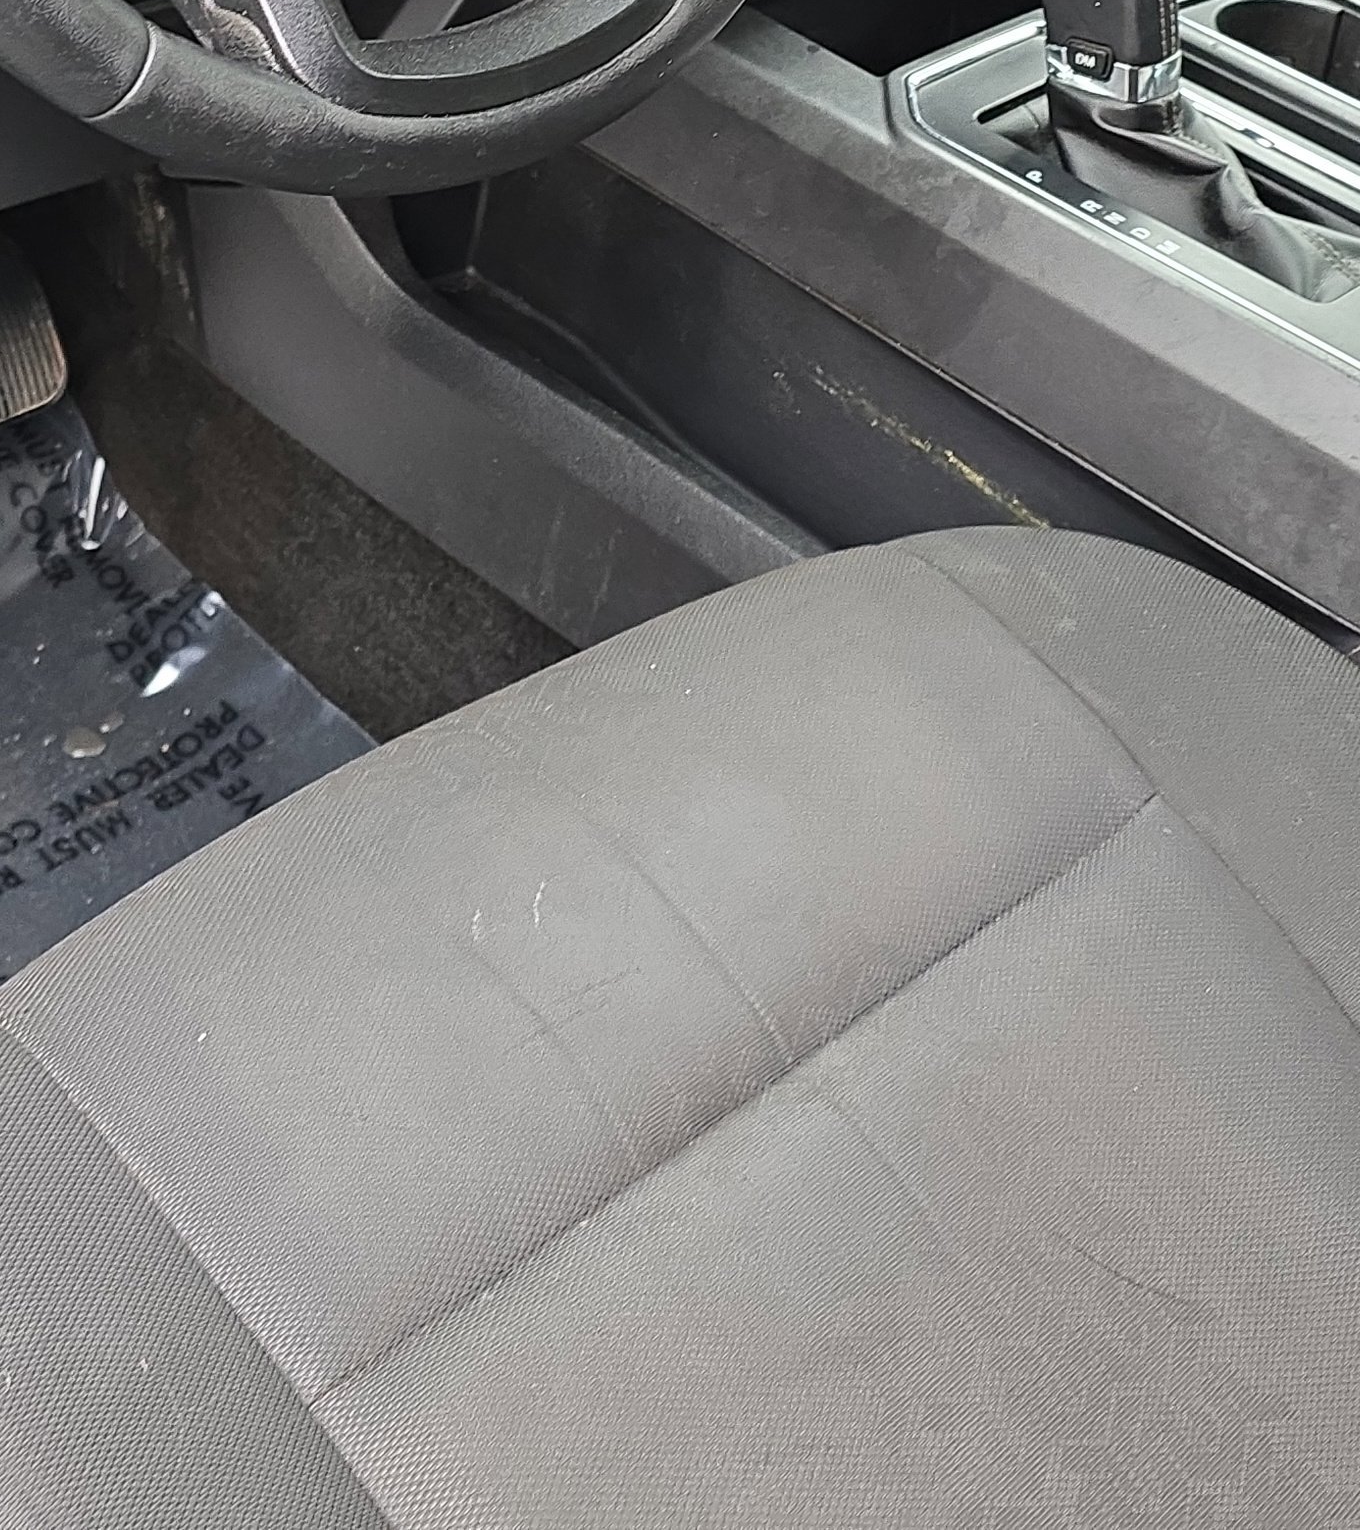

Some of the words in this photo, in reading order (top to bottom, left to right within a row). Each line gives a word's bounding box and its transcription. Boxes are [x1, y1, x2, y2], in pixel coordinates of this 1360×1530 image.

[1025, 170, 1043, 184] P
[1079, 200, 1104, 214] R
[1103, 211, 1127, 226] N
[1129, 227, 1151, 240] D
[46, 699, 239, 825] PROTECTIVE
[147, 721, 267, 812] DEALER
[35, 808, 132, 875] MUST
